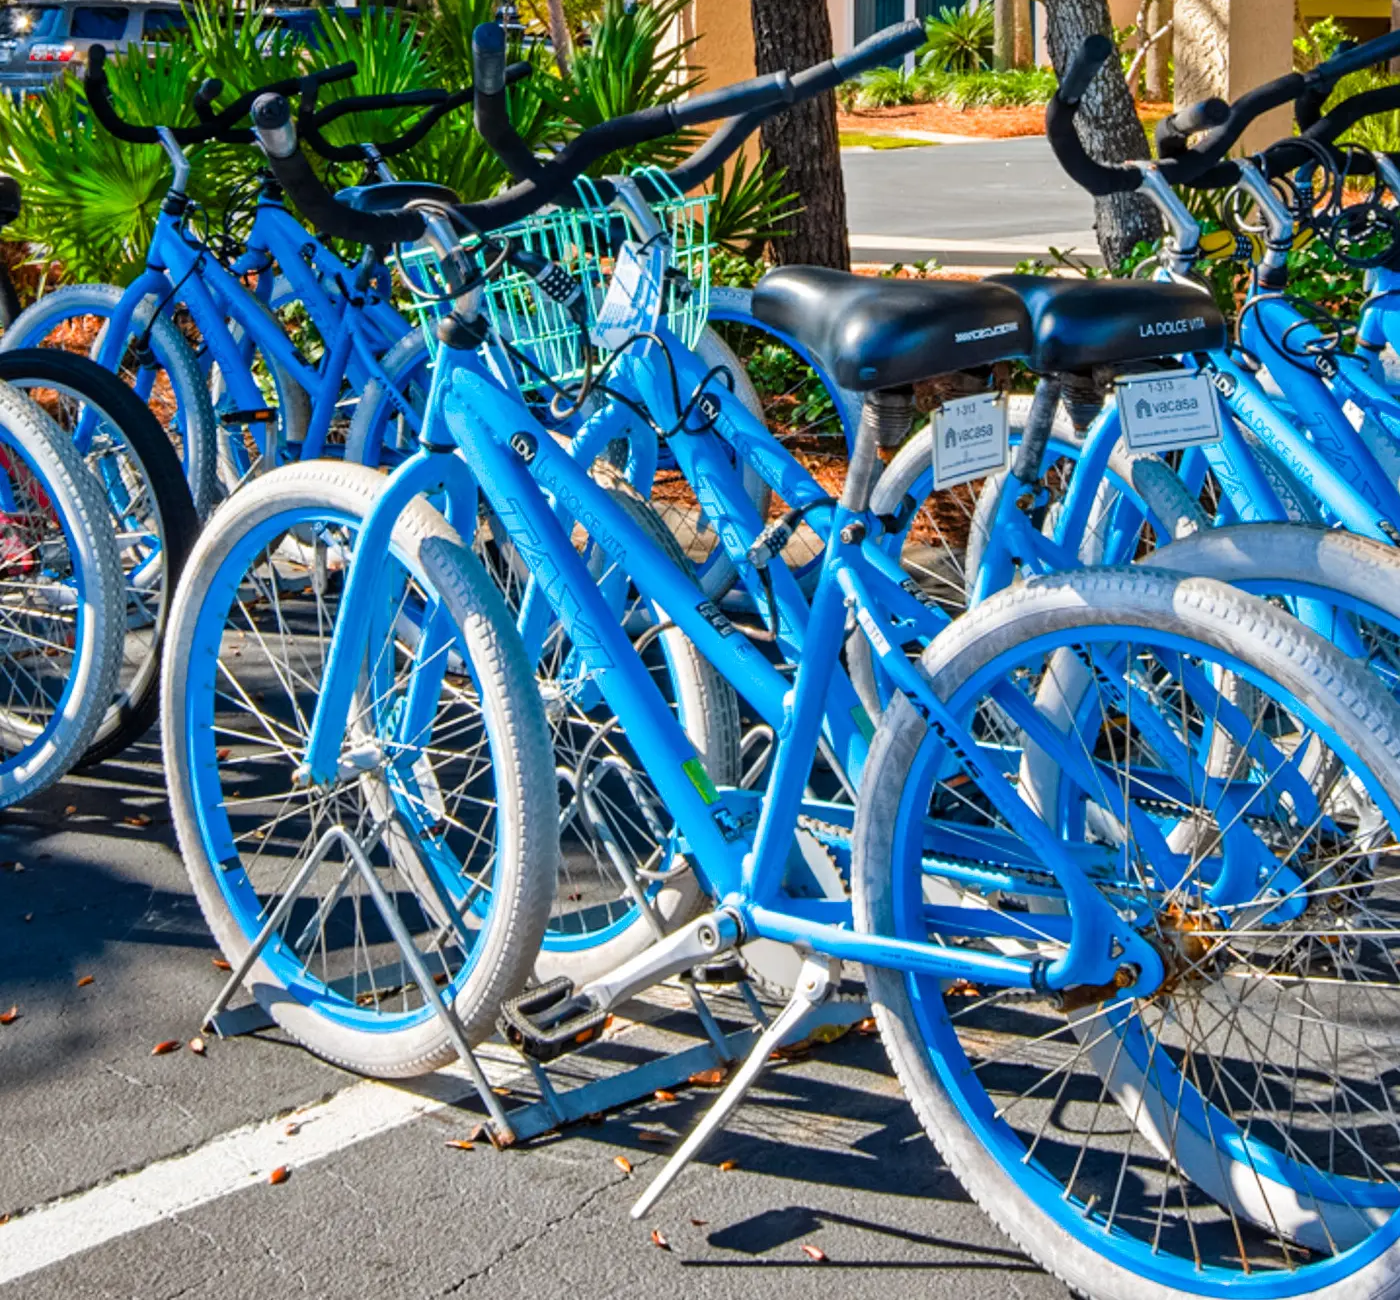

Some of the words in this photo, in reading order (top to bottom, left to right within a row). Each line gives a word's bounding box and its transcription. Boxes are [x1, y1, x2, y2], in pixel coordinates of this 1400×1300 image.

[1139, 323, 1154, 338] LA
[1155, 319, 1187, 336] DOLCE
[1189, 316, 1206, 331] VITA
[1153, 398, 1198, 414] vacasa
[957, 423, 994, 443] vacasa
[510, 434, 536, 462] LDV
